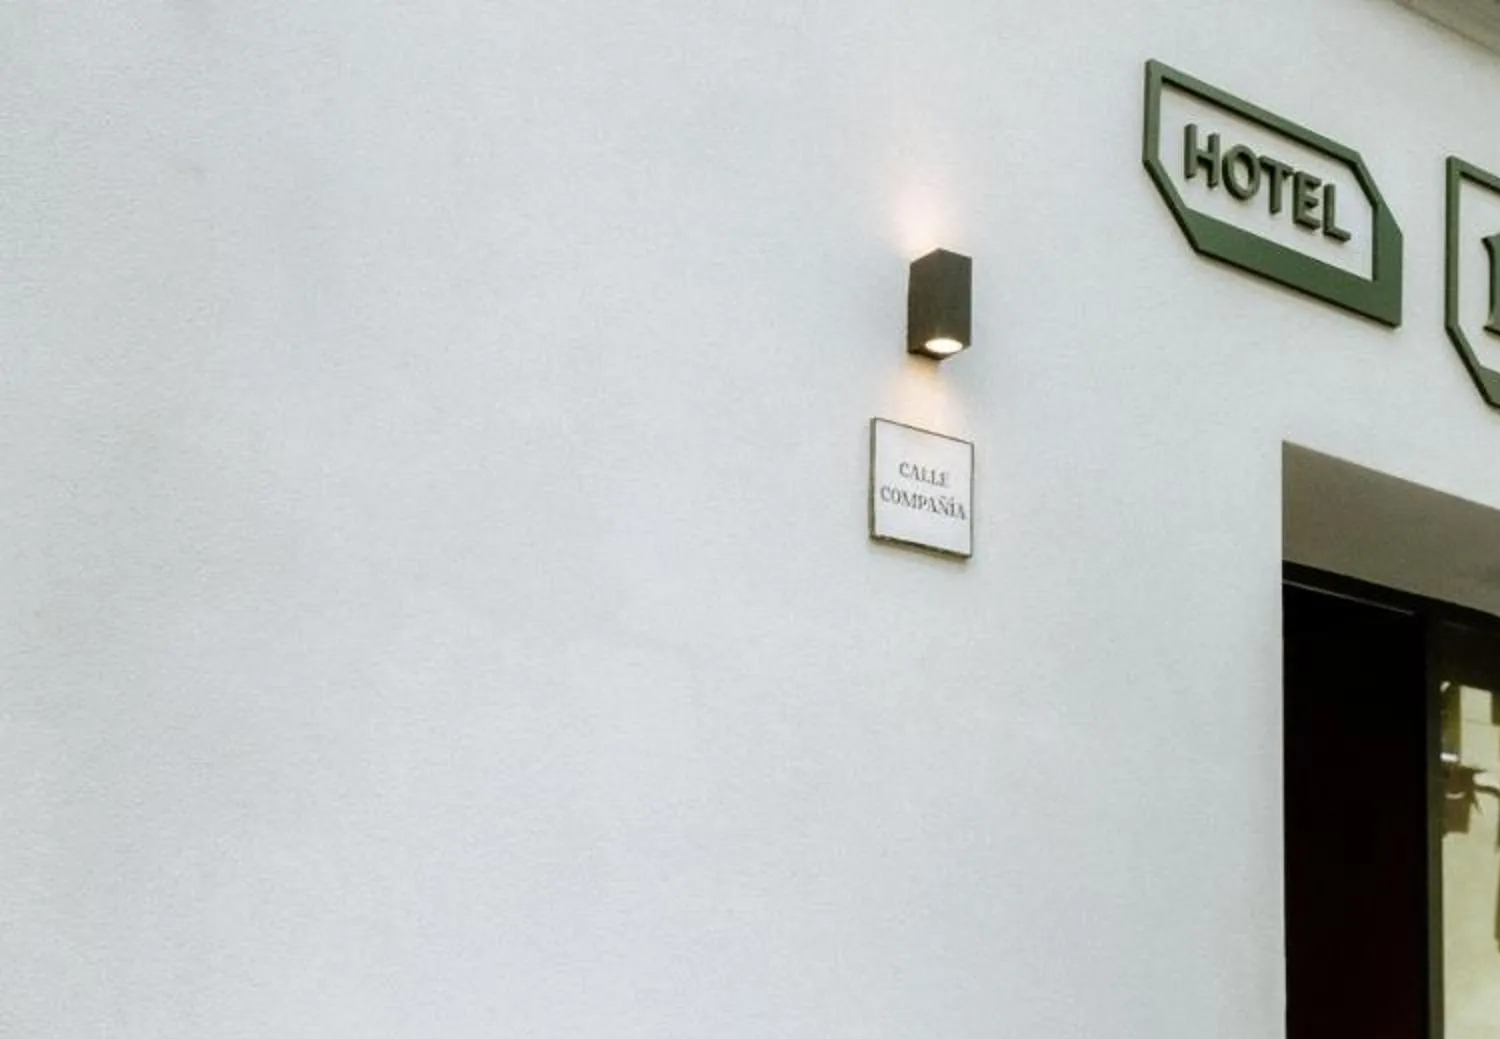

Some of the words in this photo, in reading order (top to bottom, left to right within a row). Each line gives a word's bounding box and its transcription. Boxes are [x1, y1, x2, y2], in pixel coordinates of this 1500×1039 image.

[1184, 123, 1351, 243] HOTEL
[899, 461, 950, 487] CALLE
[880, 485, 966, 520] COMPAÑÍA
